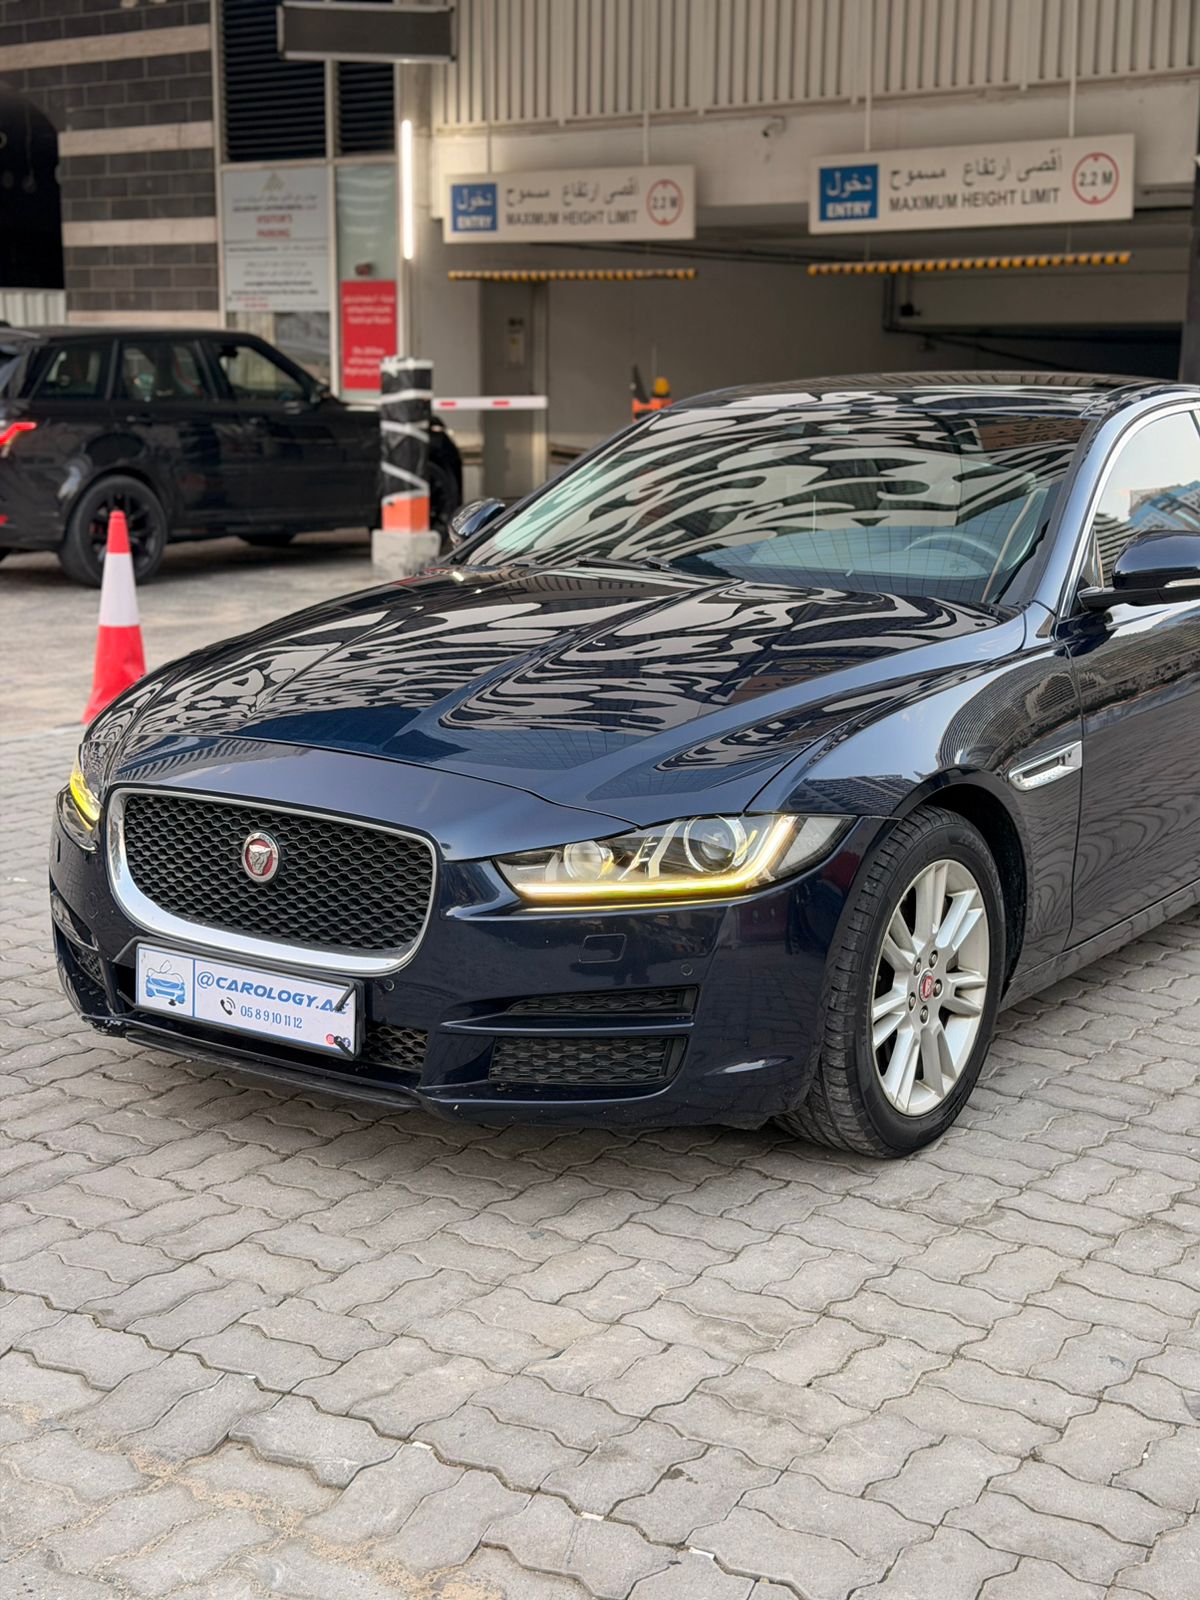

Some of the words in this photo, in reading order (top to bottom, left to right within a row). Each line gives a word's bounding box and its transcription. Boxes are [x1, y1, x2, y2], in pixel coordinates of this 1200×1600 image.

[826, 170, 873, 199] دخول
[890, 167, 946, 191] مسموح
[1078, 170, 1098, 186] 2.2
[1102, 168, 1113, 184] M
[456, 187, 494, 213] دخول
[826, 201, 872, 219] ENTRY
[889, 194, 957, 213] MAXIMUM
[961, 190, 1017, 208] HEIGHT
[1021, 187, 1060, 205] LIMIT
[456, 215, 494, 230] ENTRY
[506, 211, 559, 226] MAXIMUM
[562, 209, 604, 225] HEIGHT
[607, 208, 638, 224] LIMIT
